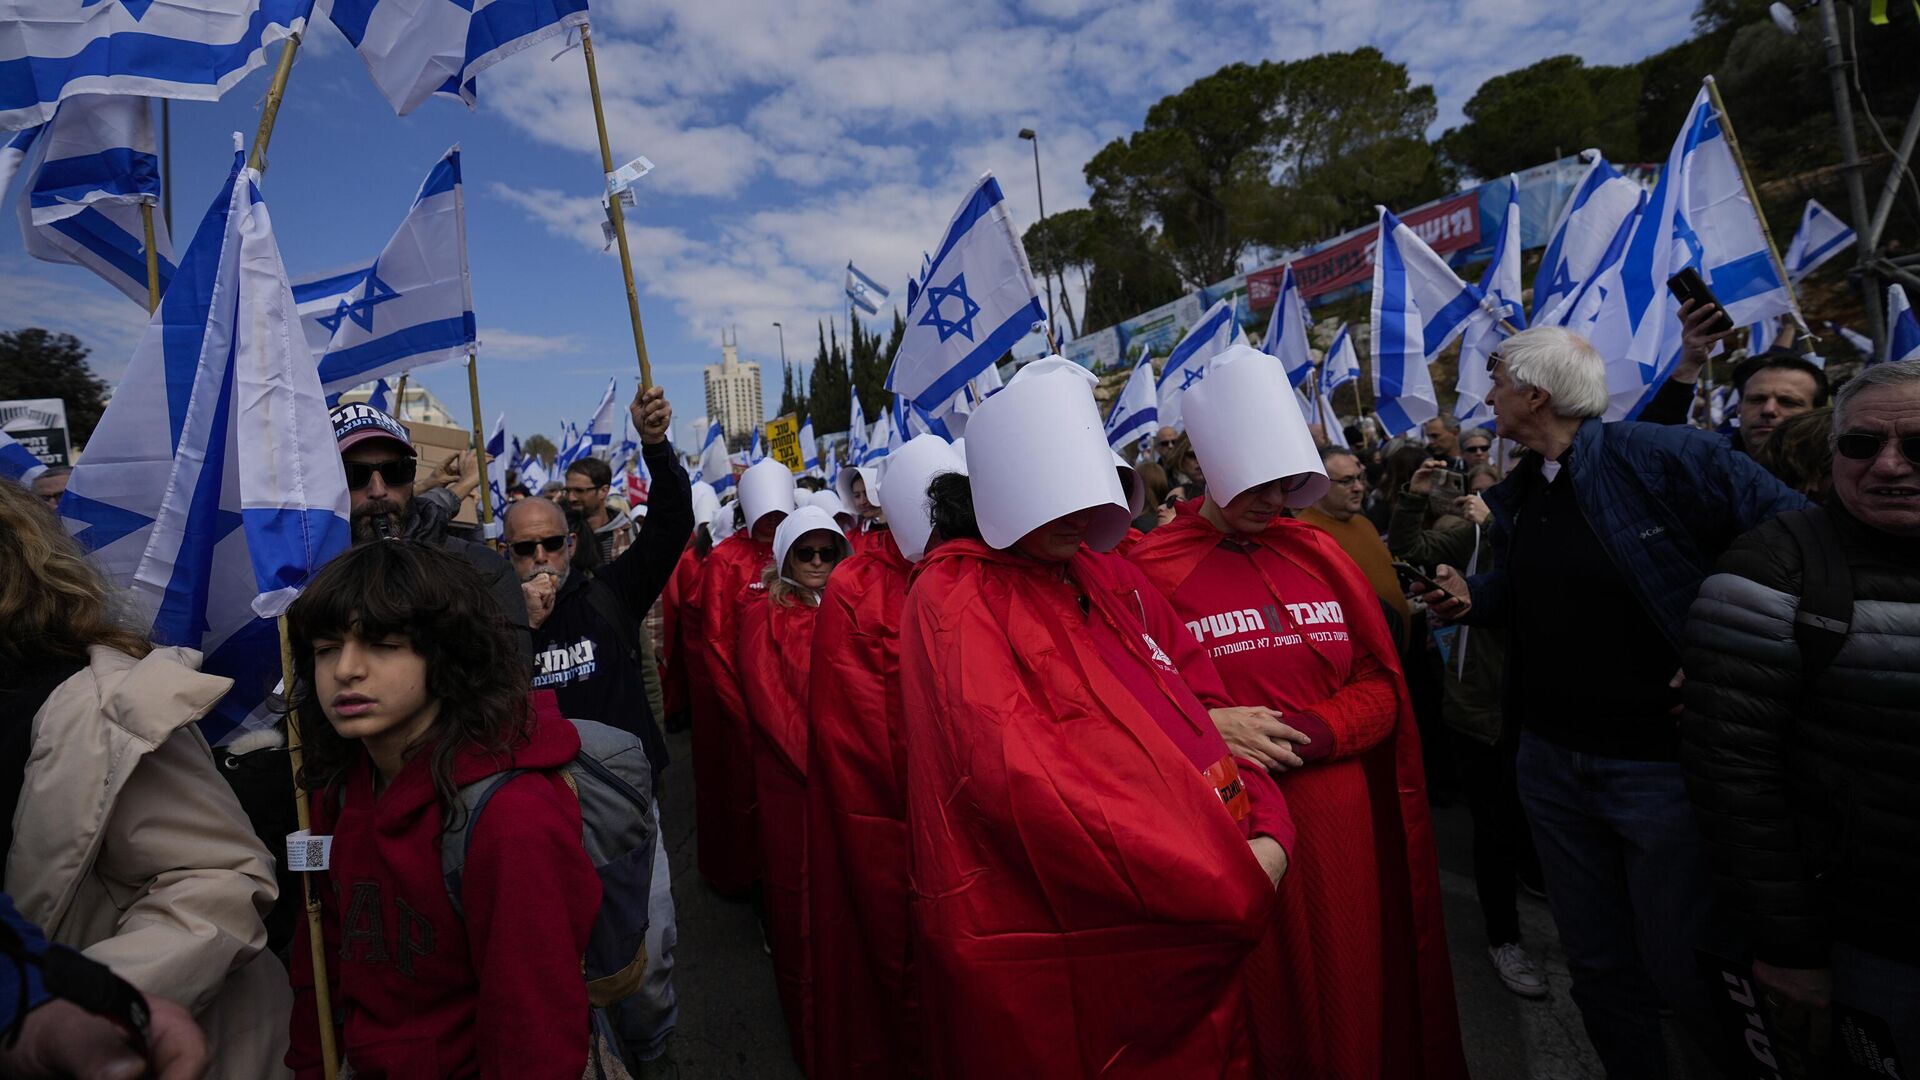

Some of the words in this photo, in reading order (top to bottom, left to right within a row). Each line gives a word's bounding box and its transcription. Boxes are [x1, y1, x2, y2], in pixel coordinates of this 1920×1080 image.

[335, 417, 373, 437] העצמ
[775, 422, 789, 436] טוב
[772, 431, 796, 448] למחות
[779, 446, 794, 458] בעד
[1285, 601, 1345, 629] מאבק
[1214, 639, 1255, 658] במשמרת
[1257, 637, 1270, 648] לא
[532, 672, 563, 687] העצמ
